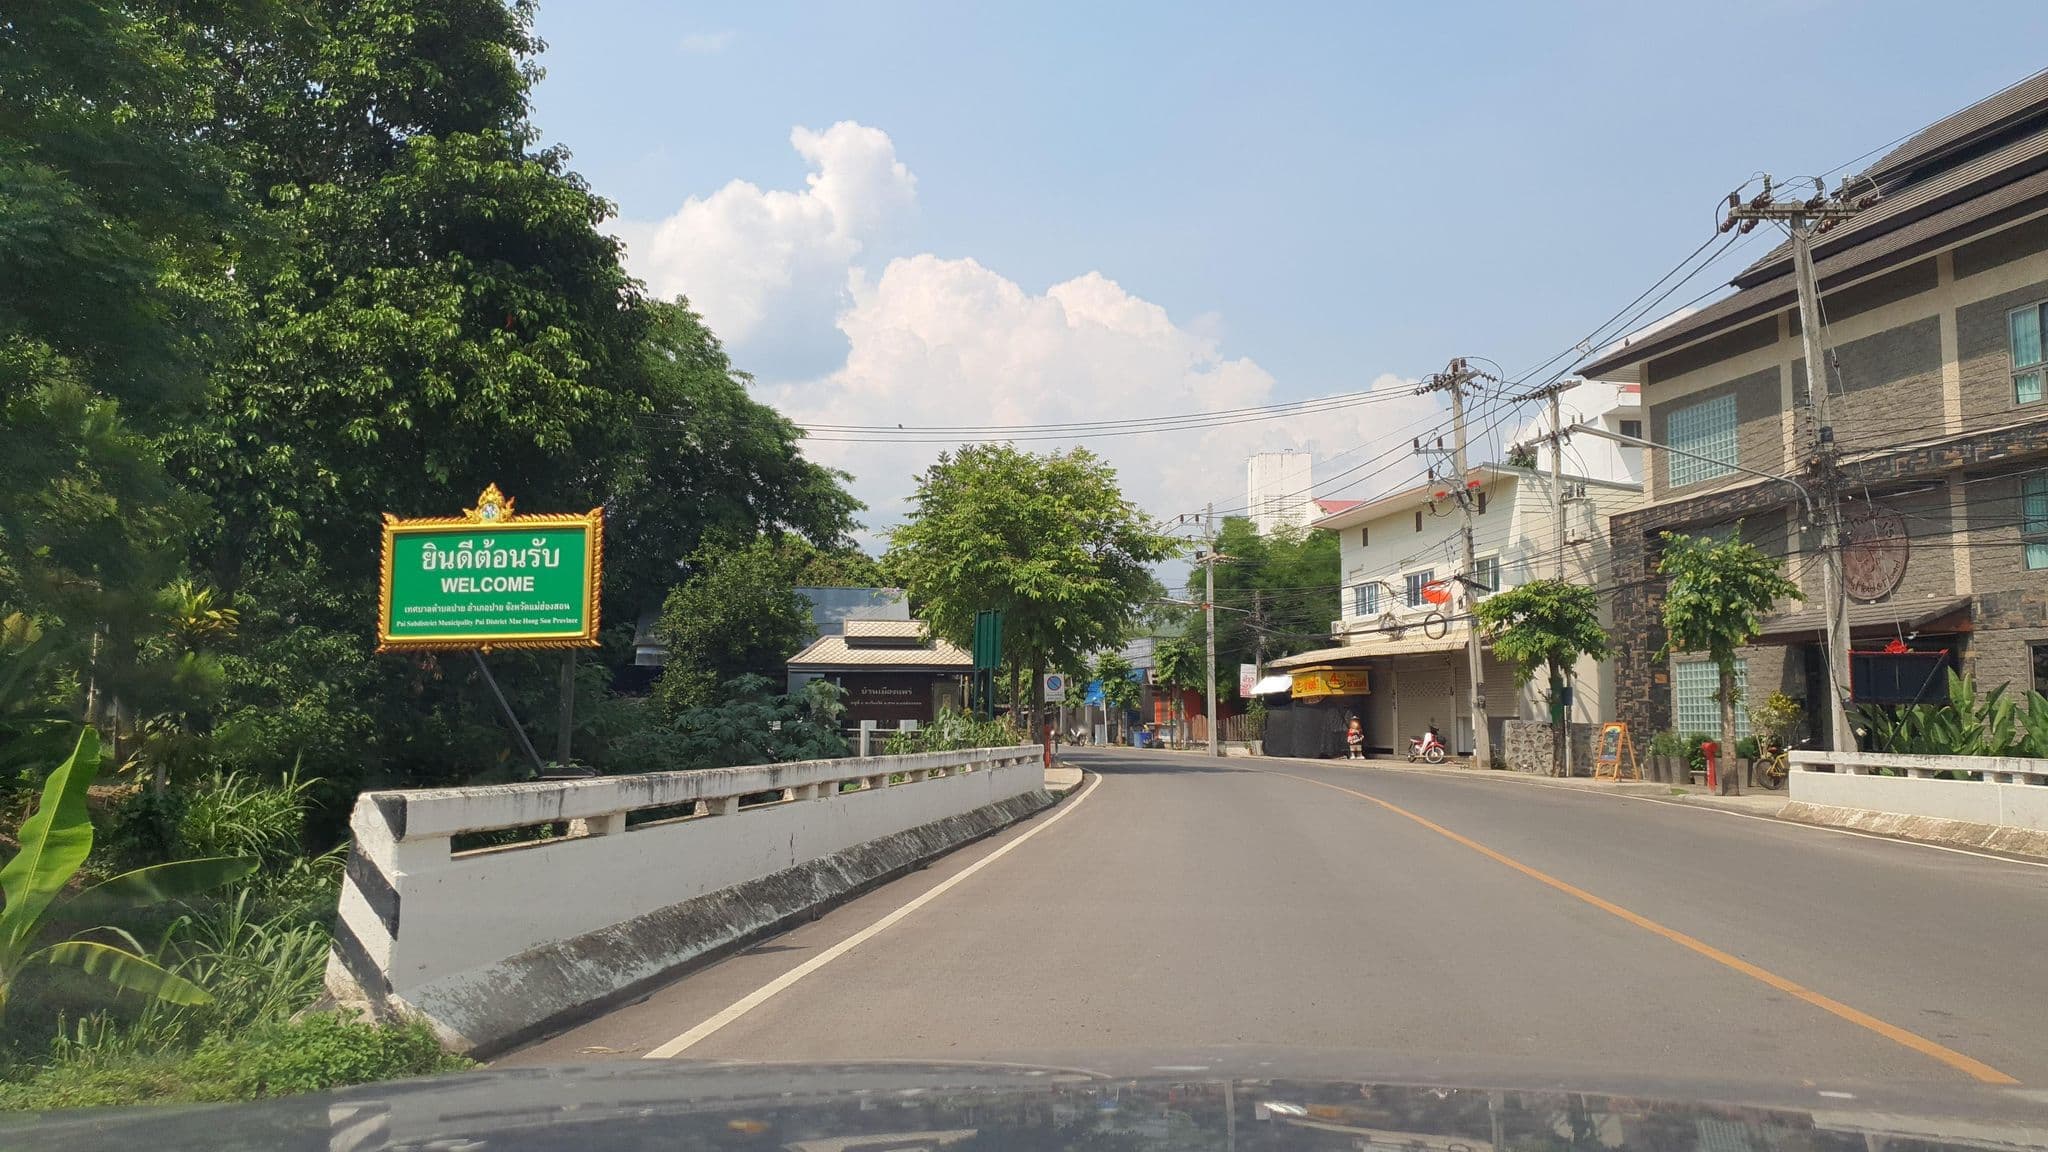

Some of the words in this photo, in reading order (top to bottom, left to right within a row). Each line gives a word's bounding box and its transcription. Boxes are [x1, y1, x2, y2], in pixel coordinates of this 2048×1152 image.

[422, 538, 560, 570] ยินดีต้อนรับ
[441, 576, 535, 592] WELCOME
[438, 619, 473, 627] Municipality
